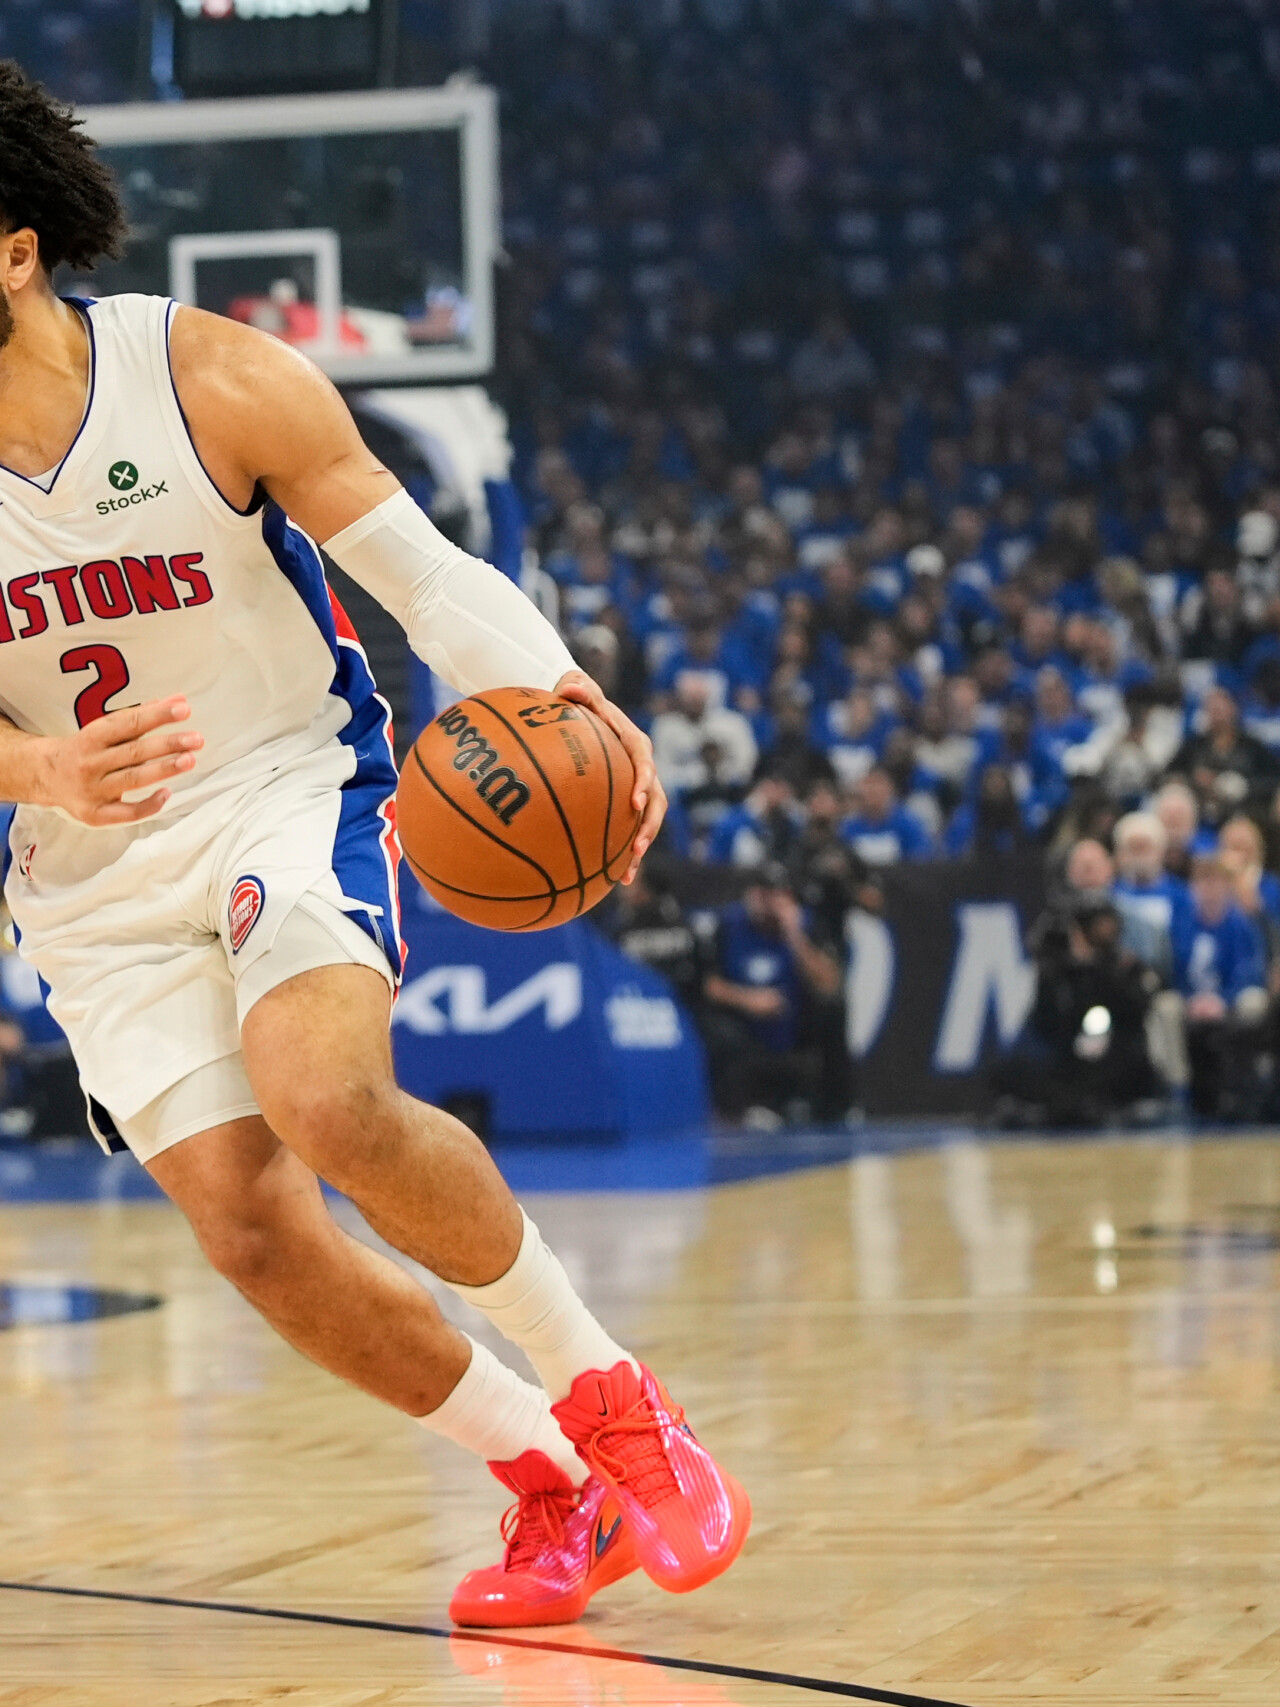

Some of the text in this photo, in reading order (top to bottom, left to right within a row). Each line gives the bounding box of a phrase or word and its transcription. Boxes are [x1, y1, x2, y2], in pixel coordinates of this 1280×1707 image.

[96, 480, 169, 515] StockX
[59, 643, 141, 730] 2
[435, 704, 531, 827] Wilson
